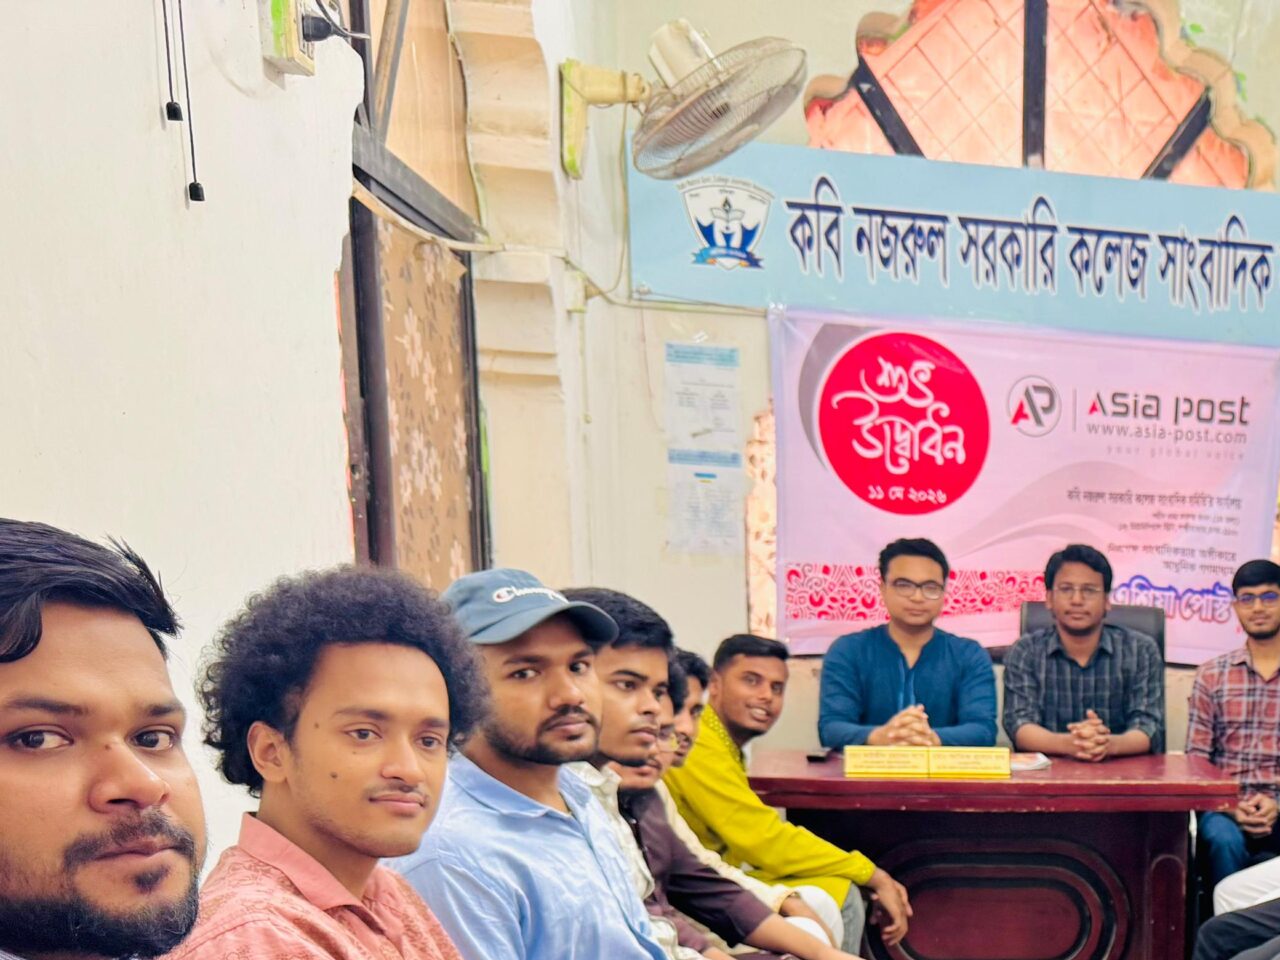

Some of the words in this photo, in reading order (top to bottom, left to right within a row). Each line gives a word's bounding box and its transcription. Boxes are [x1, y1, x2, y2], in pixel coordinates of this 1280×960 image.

[784, 175, 844, 281] কবি
[851, 206, 949, 288] নজরুল
[957, 195, 1059, 294] সরকারি
[1066, 225, 1150, 302] কলেজ
[1157, 214, 1273, 312] সাংবাদিক
[859, 355, 937, 408] শুভ
[1173, 395, 1251, 426] post
[831, 389, 967, 475] উদ্বোধন
[1086, 423, 1248, 445] www.asia-post.com
[868, 484, 885, 500] ১১
[888, 486, 905, 501] মে
[909, 487, 948, 505] ২০২৬
